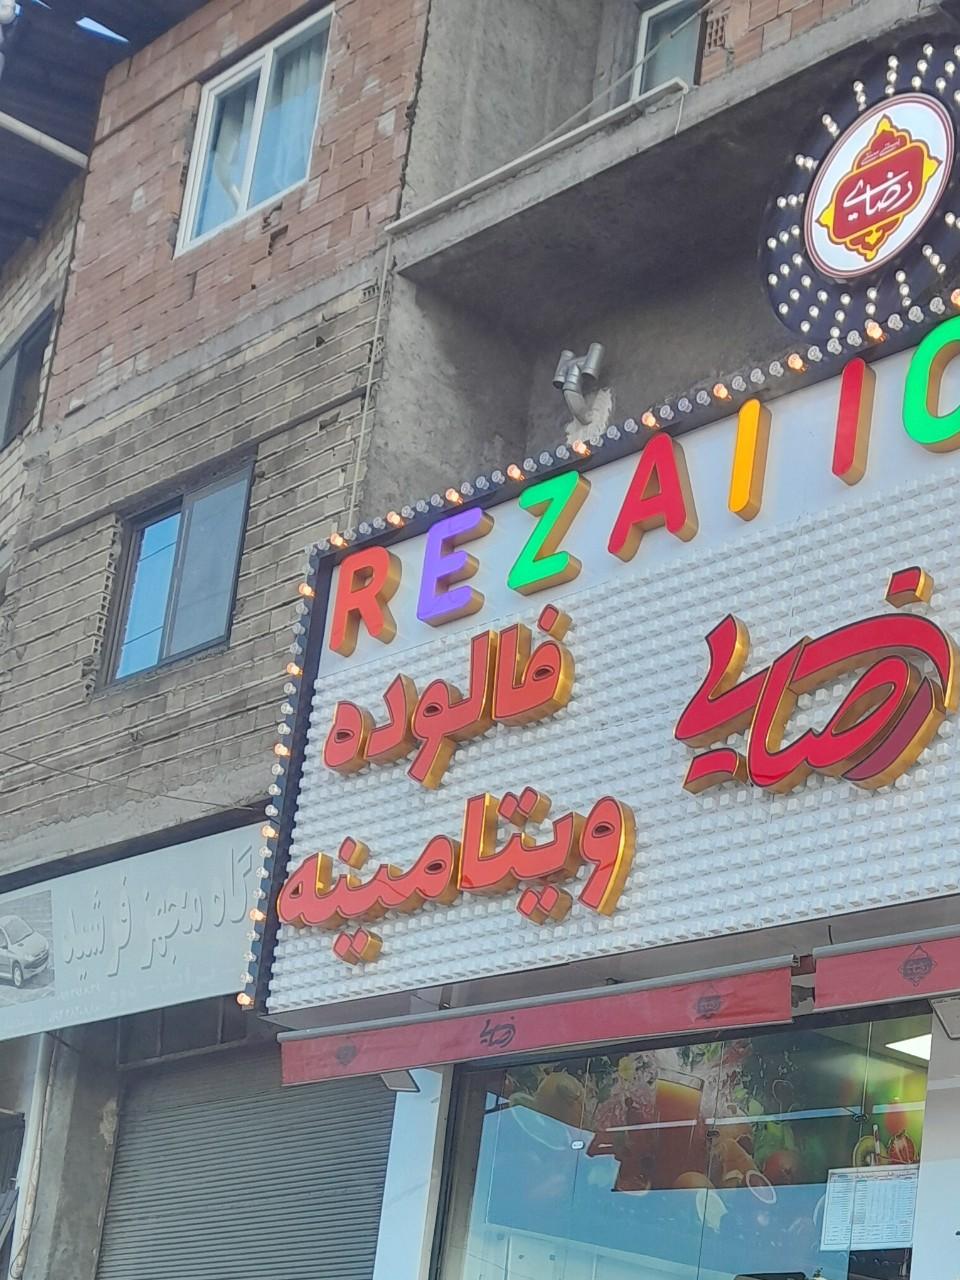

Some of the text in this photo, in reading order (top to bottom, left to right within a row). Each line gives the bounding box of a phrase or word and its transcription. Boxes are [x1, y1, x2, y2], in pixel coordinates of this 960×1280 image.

[329, 398, 771, 656] REZAI
[323, 604, 575, 789] فالوده
[277, 786, 639, 966] ویتامینه
